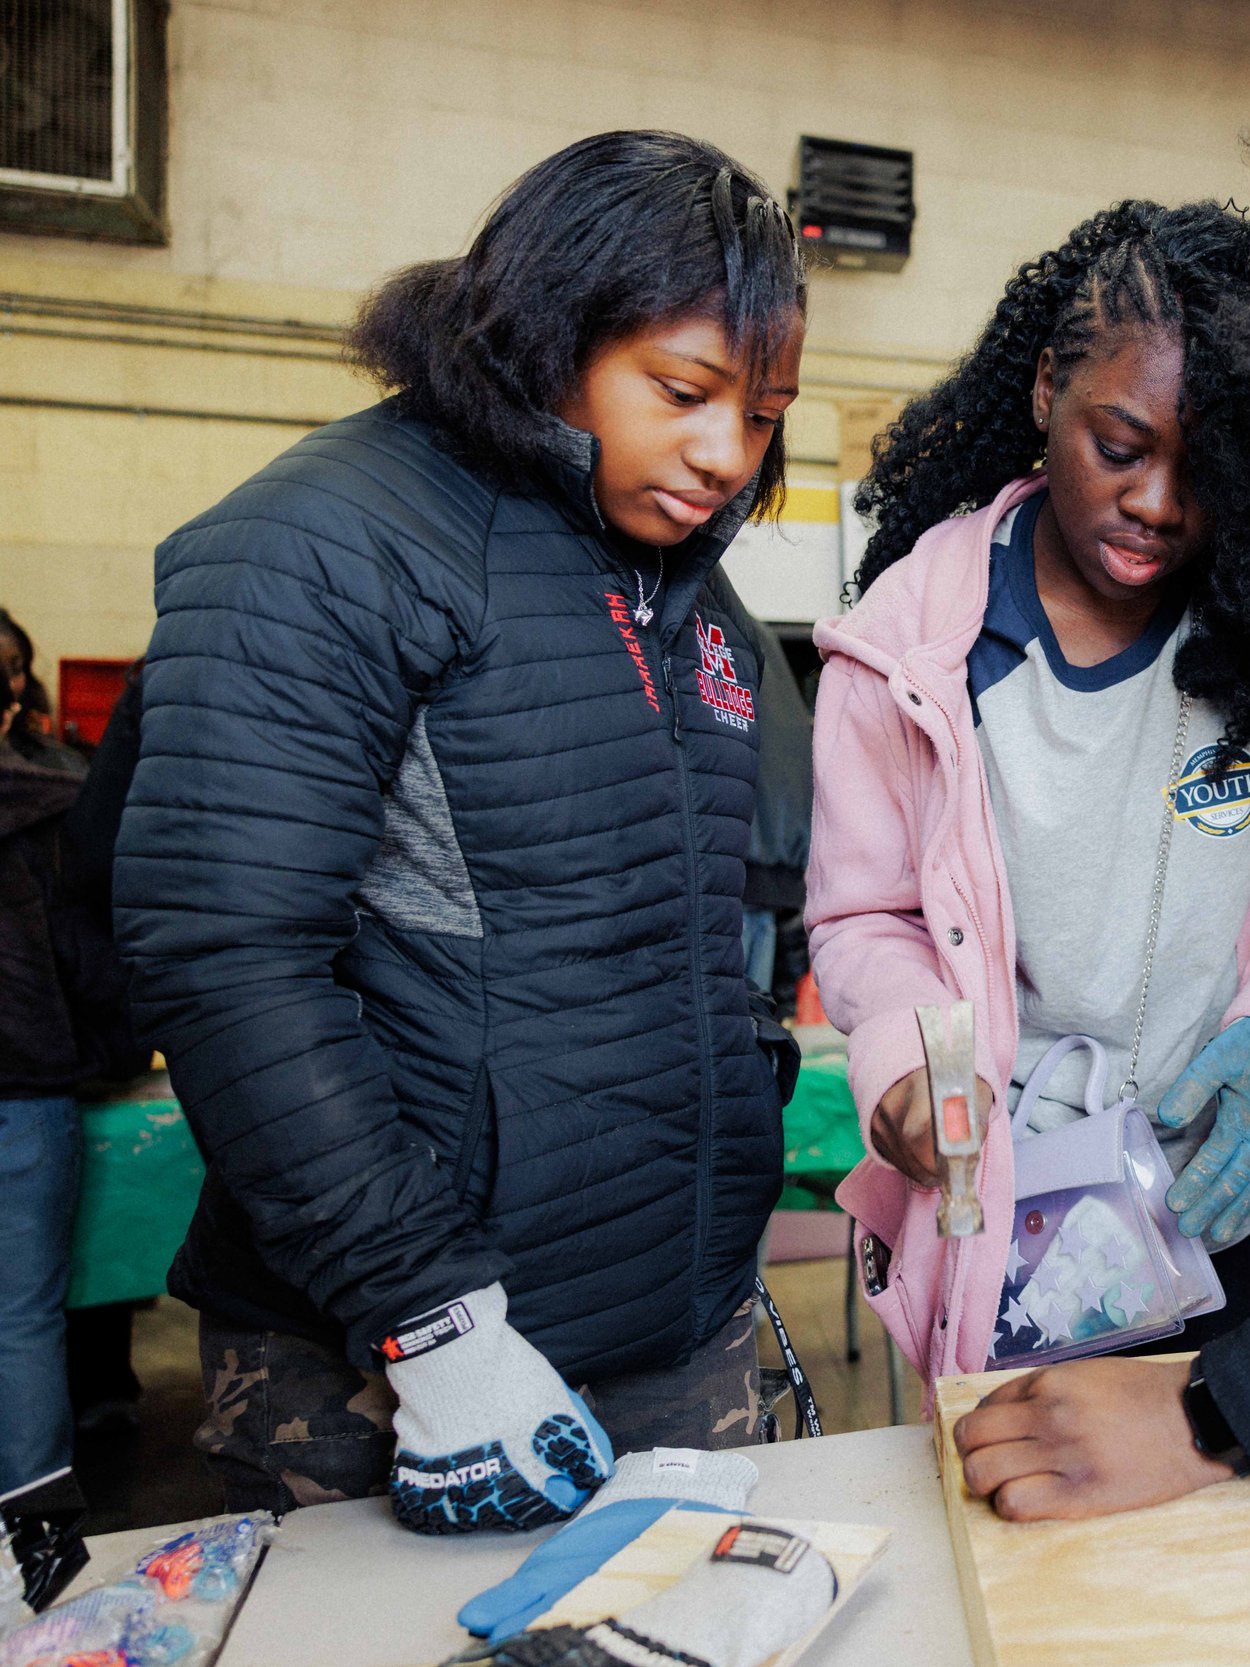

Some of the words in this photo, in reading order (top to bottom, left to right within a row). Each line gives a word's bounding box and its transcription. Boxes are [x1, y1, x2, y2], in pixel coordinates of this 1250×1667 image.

[695, 668, 755, 722] BULLDOGS
[714, 709, 749, 732] CHEER
[1210, 808, 1244, 820] SERVICES
[769, 1300, 804, 1386] VIBES
[398, 1458, 501, 1489] PREDATOR
